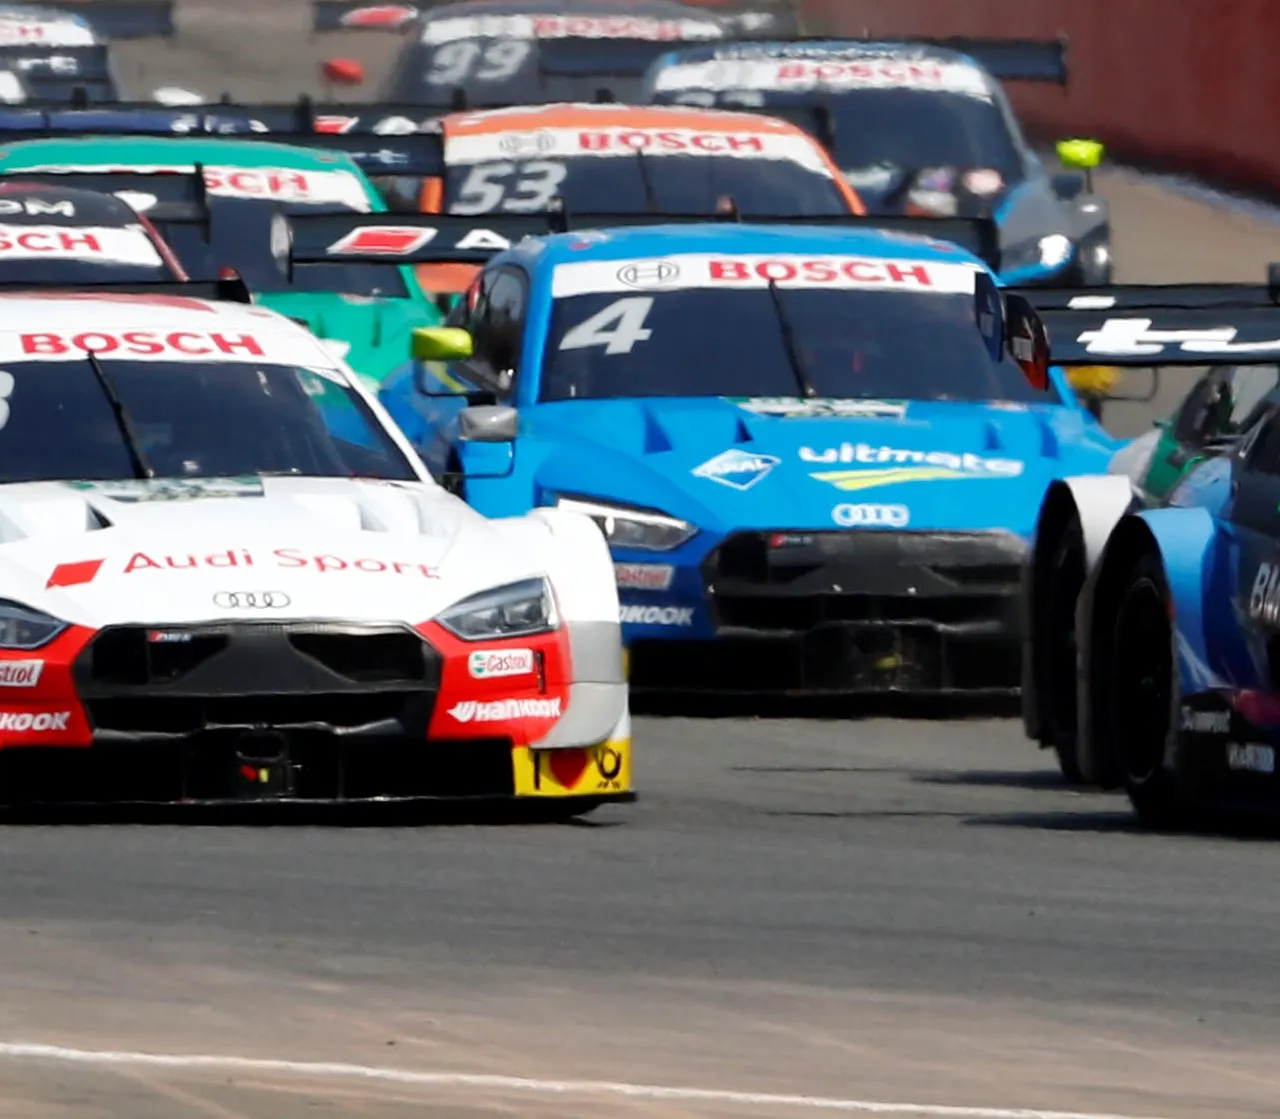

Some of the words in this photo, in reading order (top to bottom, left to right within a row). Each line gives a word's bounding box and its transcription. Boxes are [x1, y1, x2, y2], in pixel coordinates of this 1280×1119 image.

[531, 15, 682, 41] BOSCH
[427, 40, 532, 86] 99
[777, 63, 942, 81] BOSCH
[579, 131, 764, 153] BOSCH
[450, 161, 567, 215] 53
[708, 259, 933, 285] BOSCH
[559, 296, 653, 355] 4
[20, 332, 266, 357] BOSCH
[798, 442, 1024, 477] ultimate
[122, 547, 255, 574] Audi
[272, 547, 441, 580] Sport
[485, 652, 531, 673] Castrol
